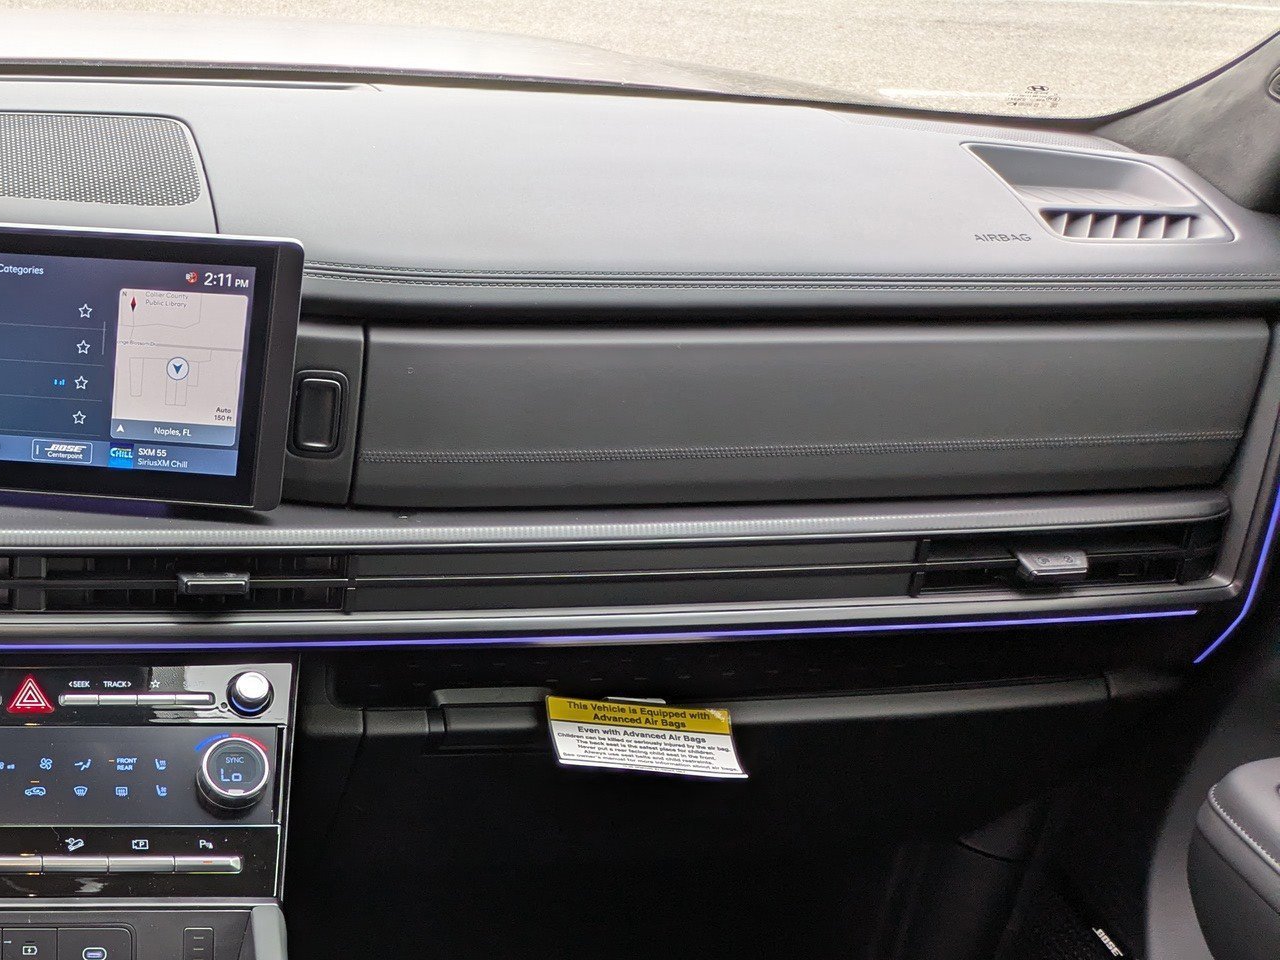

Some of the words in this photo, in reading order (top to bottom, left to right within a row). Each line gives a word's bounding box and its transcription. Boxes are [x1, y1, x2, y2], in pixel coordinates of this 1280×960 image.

[974, 233, 1032, 243] AIRBAG
[204, 272, 232, 287] 2:11
[235, 279, 249, 288] PM
[166, 292, 189, 300] County
[165, 300, 188, 308] Library
[154, 427, 181, 437] Naples,
[183, 428, 191, 437] FL
[44, 444, 87, 453] BOSE
[110, 447, 133, 458] CHILL
[138, 448, 155, 456] SXM
[156, 449, 167, 457] 55
[47, 451, 83, 460] Centerpoint
[137, 458, 169, 468] SiriusXM
[171, 459, 188, 468] Chill
[567, 701, 588, 710] This
[590, 703, 626, 714] Vehicle
[629, 706, 638, 714] is
[640, 708, 686, 719] Equipped
[689, 712, 710, 720] with
[593, 714, 642, 724] Advanced
[644, 718, 658, 726] Air
[661, 719, 687, 729] Bags
[578, 726, 600, 734] Even
[602, 728, 620, 736] with
[622, 730, 667, 740] Advanced
[683, 736, 707, 744] Bags
[1091, 927, 1123, 957] BOSE
